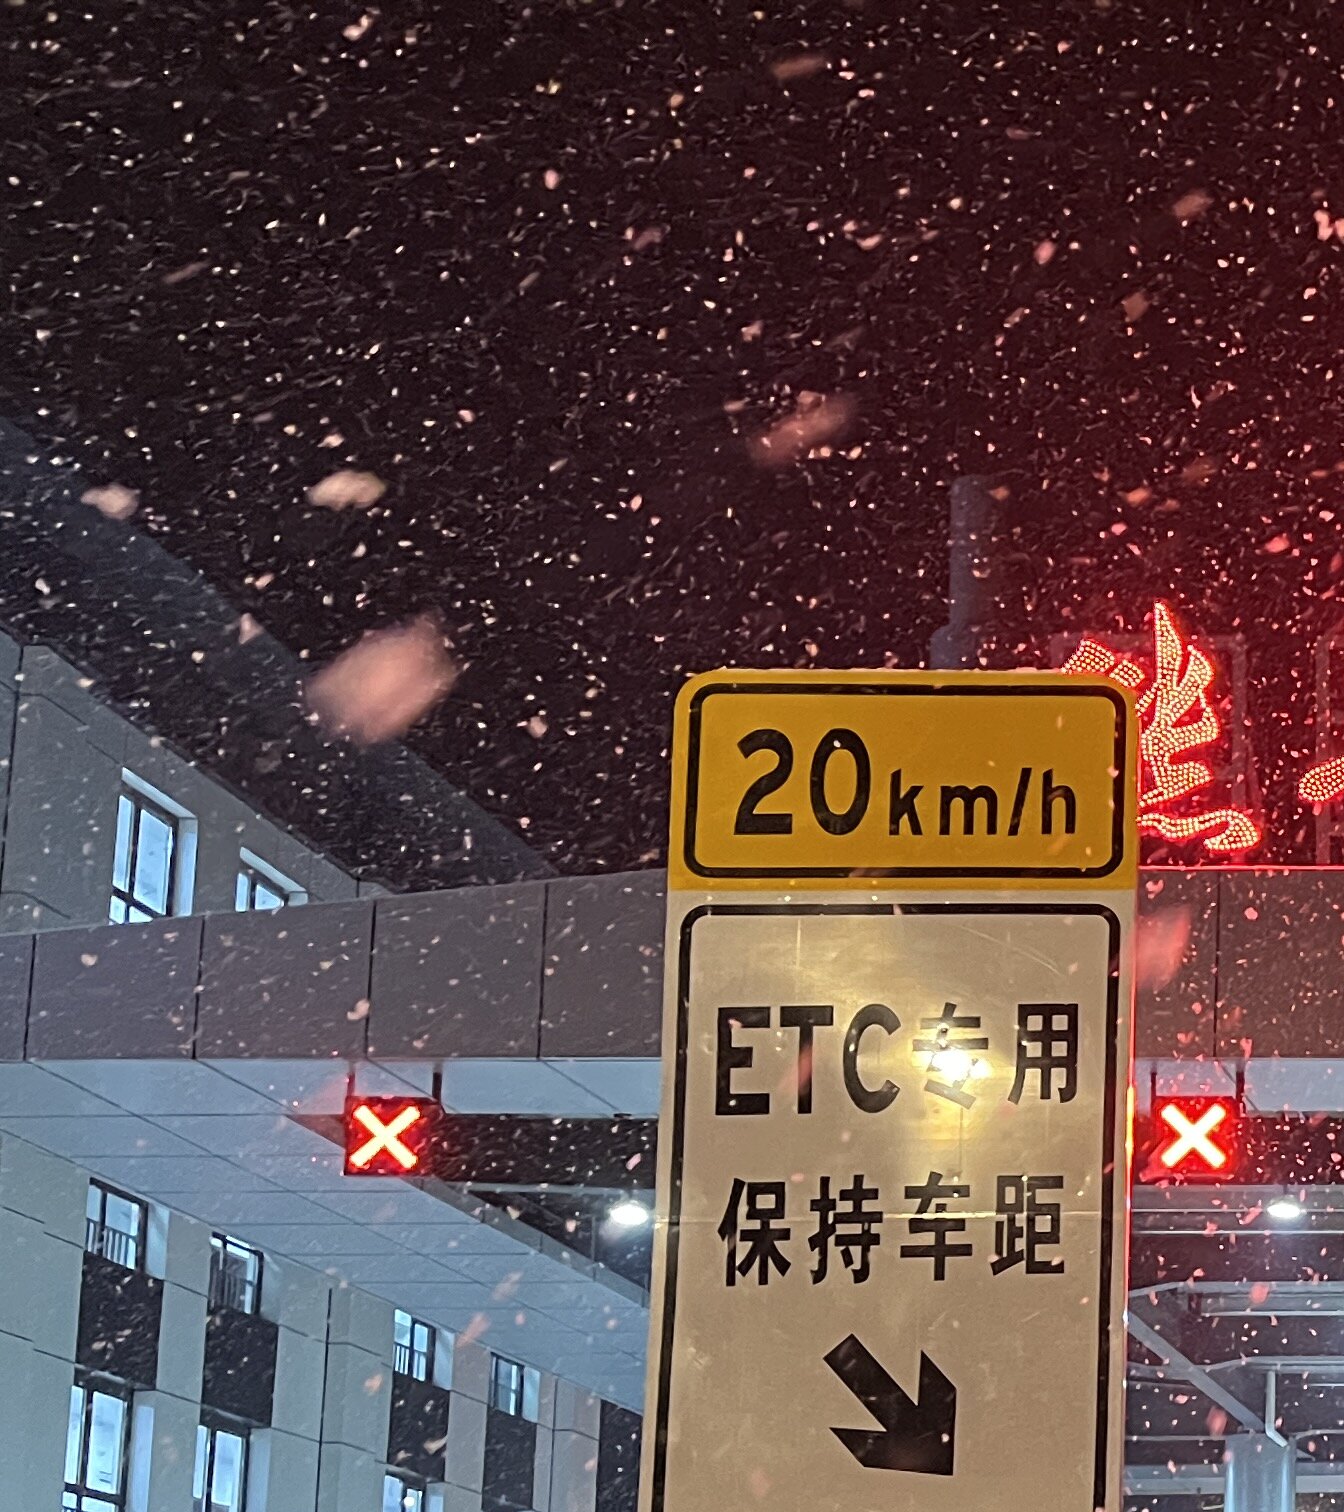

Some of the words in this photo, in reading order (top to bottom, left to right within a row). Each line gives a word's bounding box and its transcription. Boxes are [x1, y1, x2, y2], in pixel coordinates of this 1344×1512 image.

[714, 1001, 1079, 1116] ETC专用
[716, 1170, 1067, 1287] 保持车距
